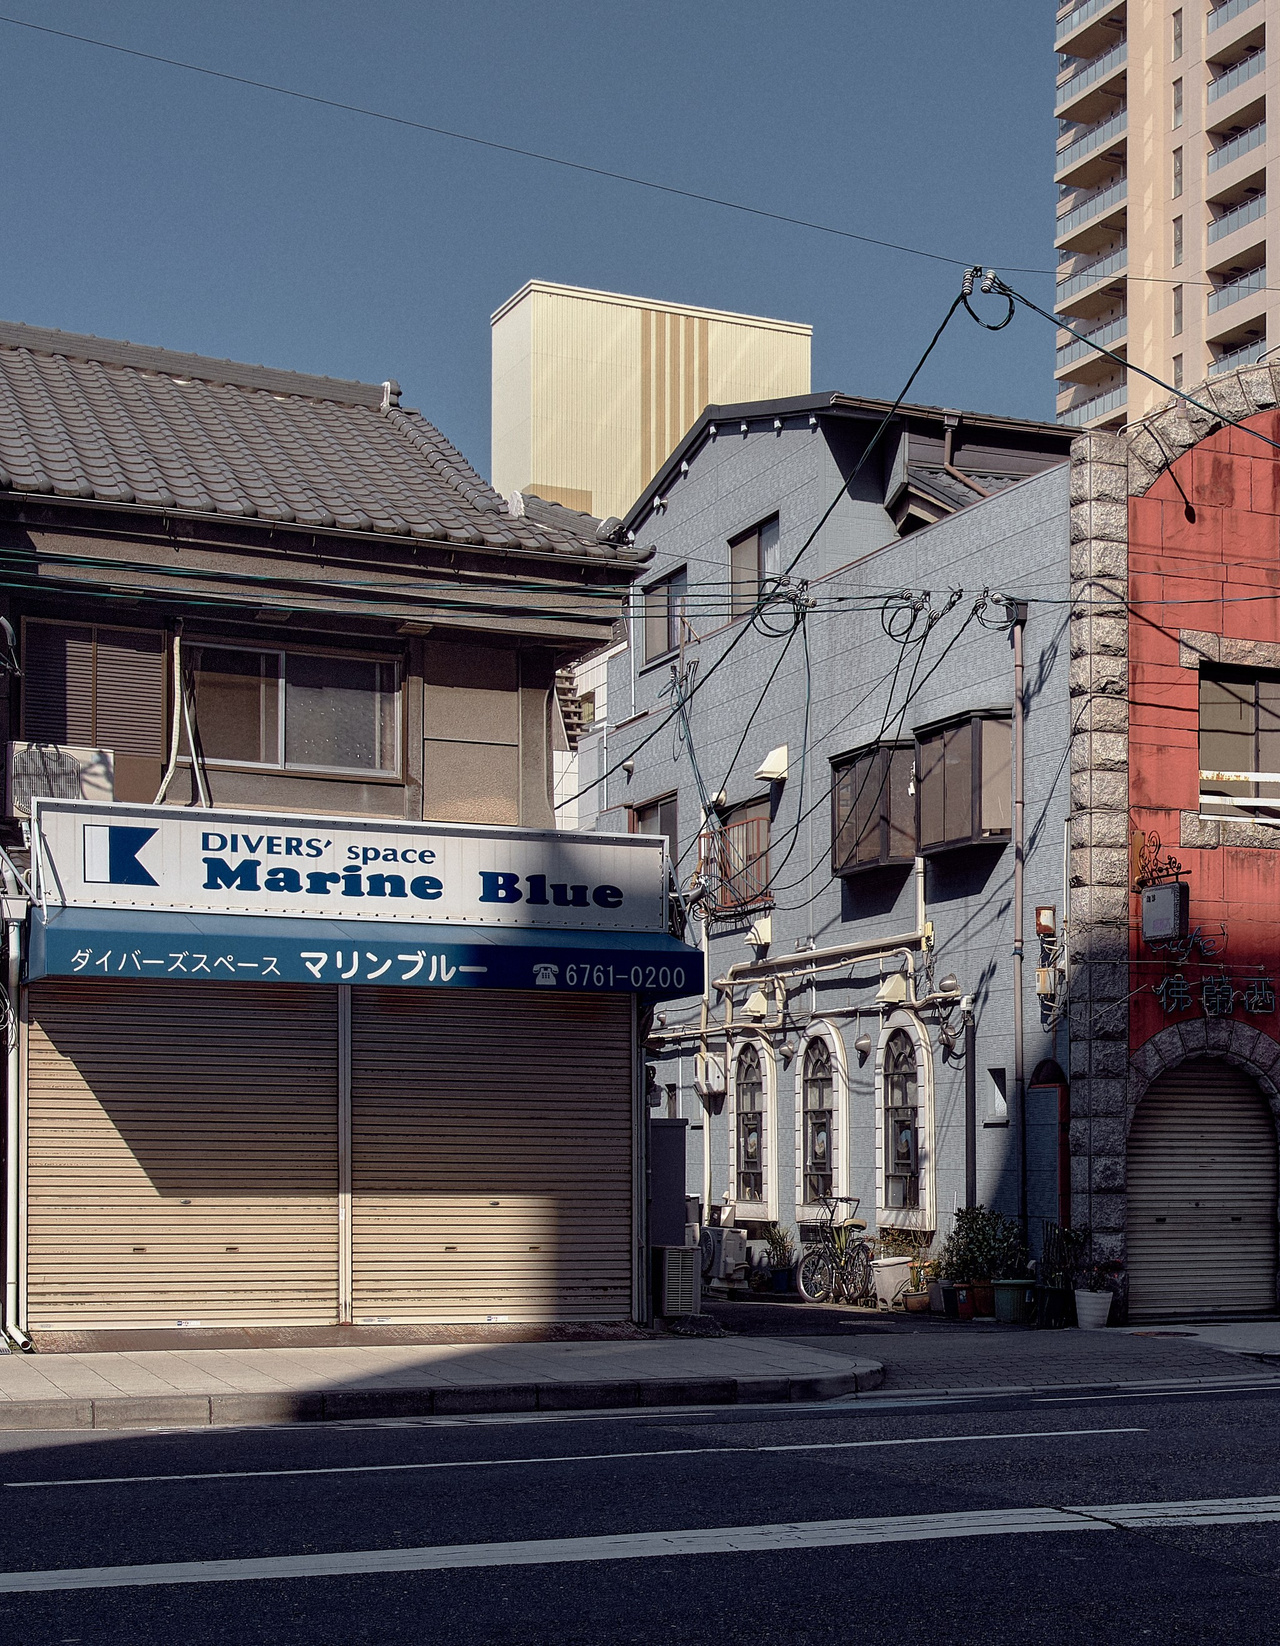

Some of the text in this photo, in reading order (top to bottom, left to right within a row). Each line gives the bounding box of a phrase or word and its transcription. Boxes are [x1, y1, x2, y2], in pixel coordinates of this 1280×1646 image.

[201, 831, 437, 865] DIVERS' space
[202, 856, 624, 909] Marine Blue
[70, 949, 686, 989] ダイバーズスペース マリンブルー 6761-0200
